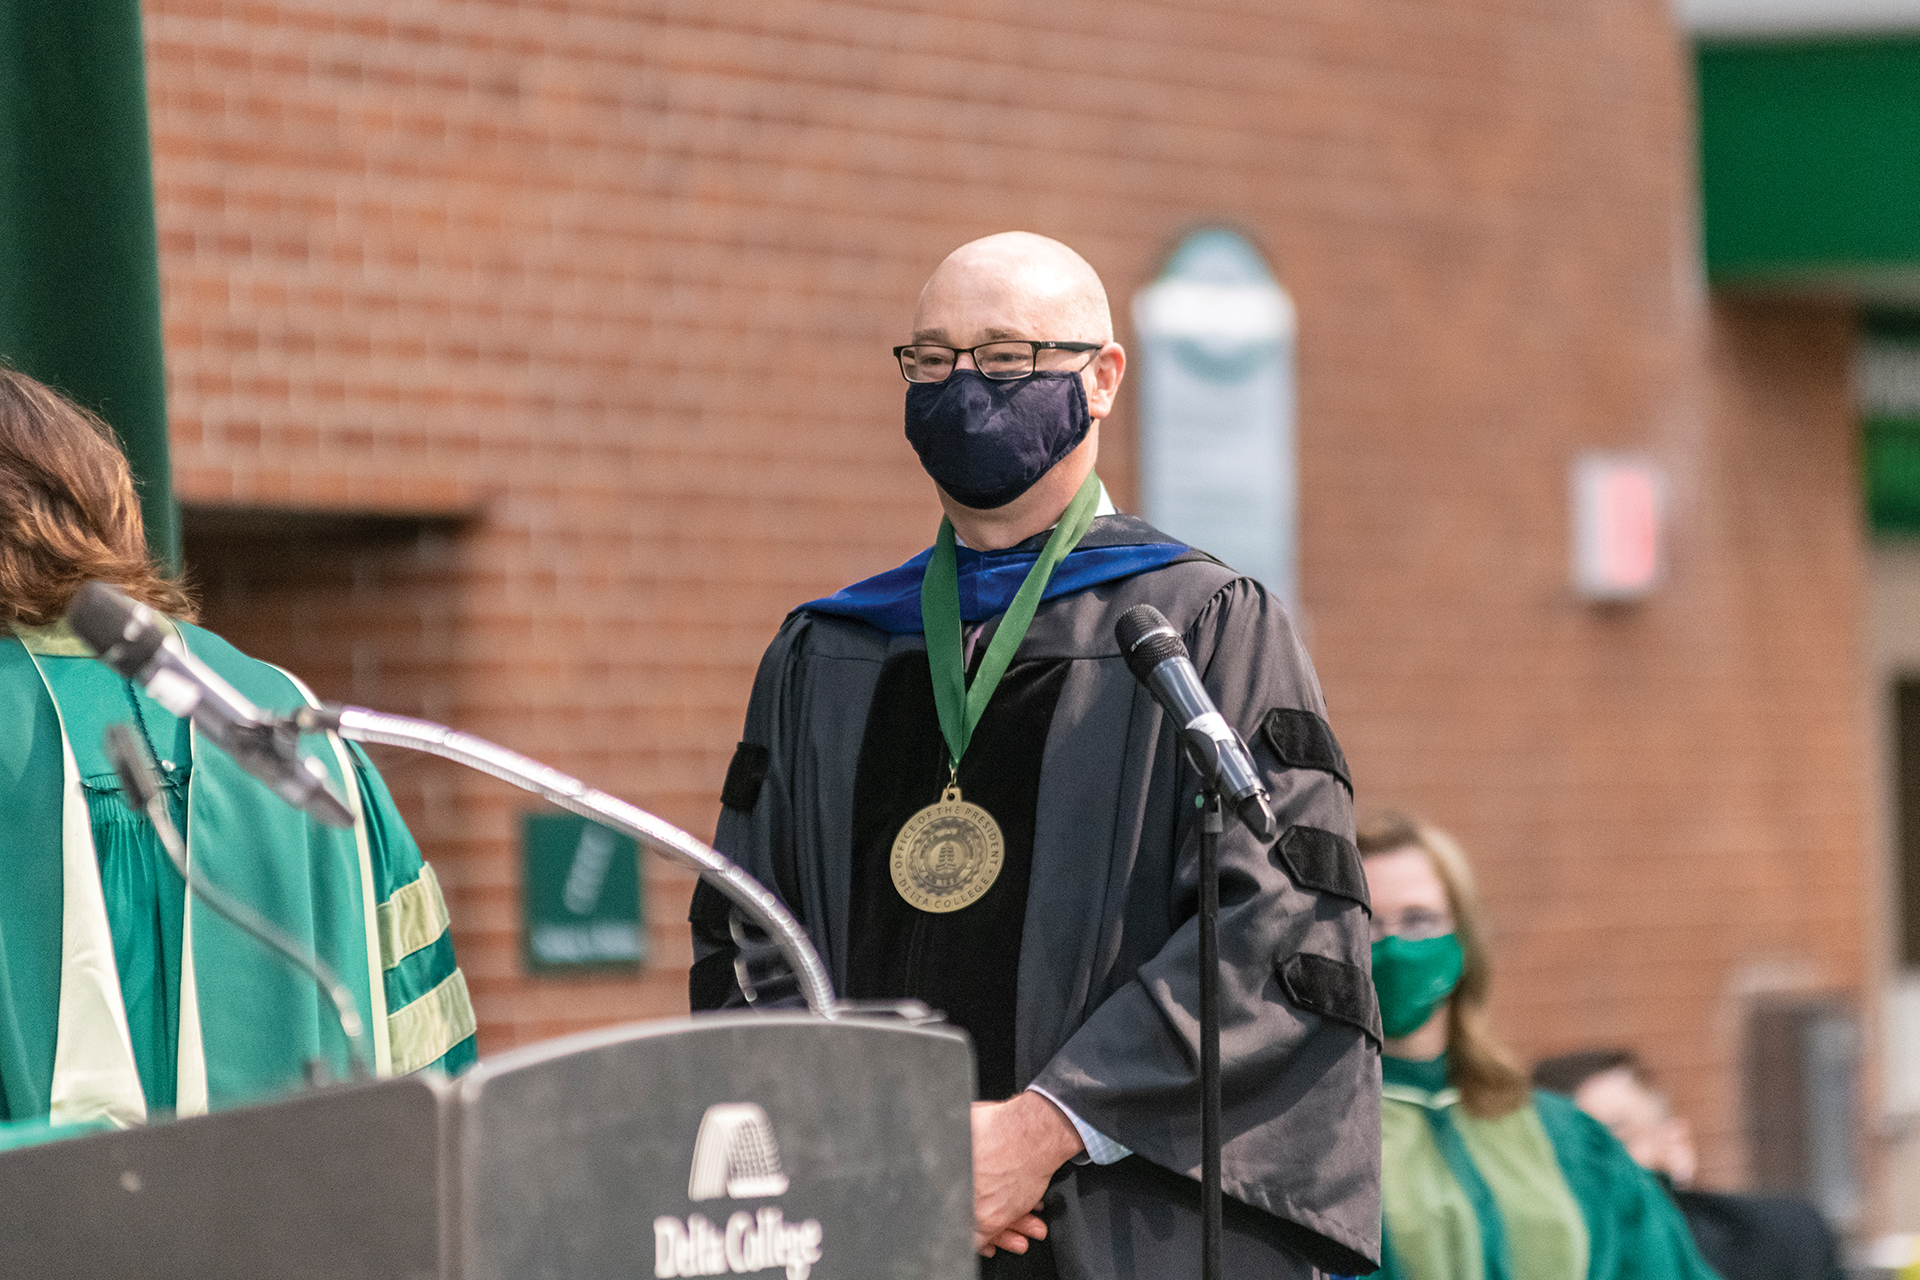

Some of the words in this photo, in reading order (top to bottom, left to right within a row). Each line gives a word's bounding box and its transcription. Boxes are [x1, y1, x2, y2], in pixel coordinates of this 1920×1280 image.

[894, 824, 916, 869] OFFICE
[917, 811, 932, 825] OF
[936, 805, 961, 816] THE
[964, 807, 1000, 867] PRESIDENT
[898, 878, 929, 907] DELTA
[934, 877, 989, 909] COLLEGE
[653, 1213, 729, 1279] Delta
[725, 1206, 823, 1280] College
